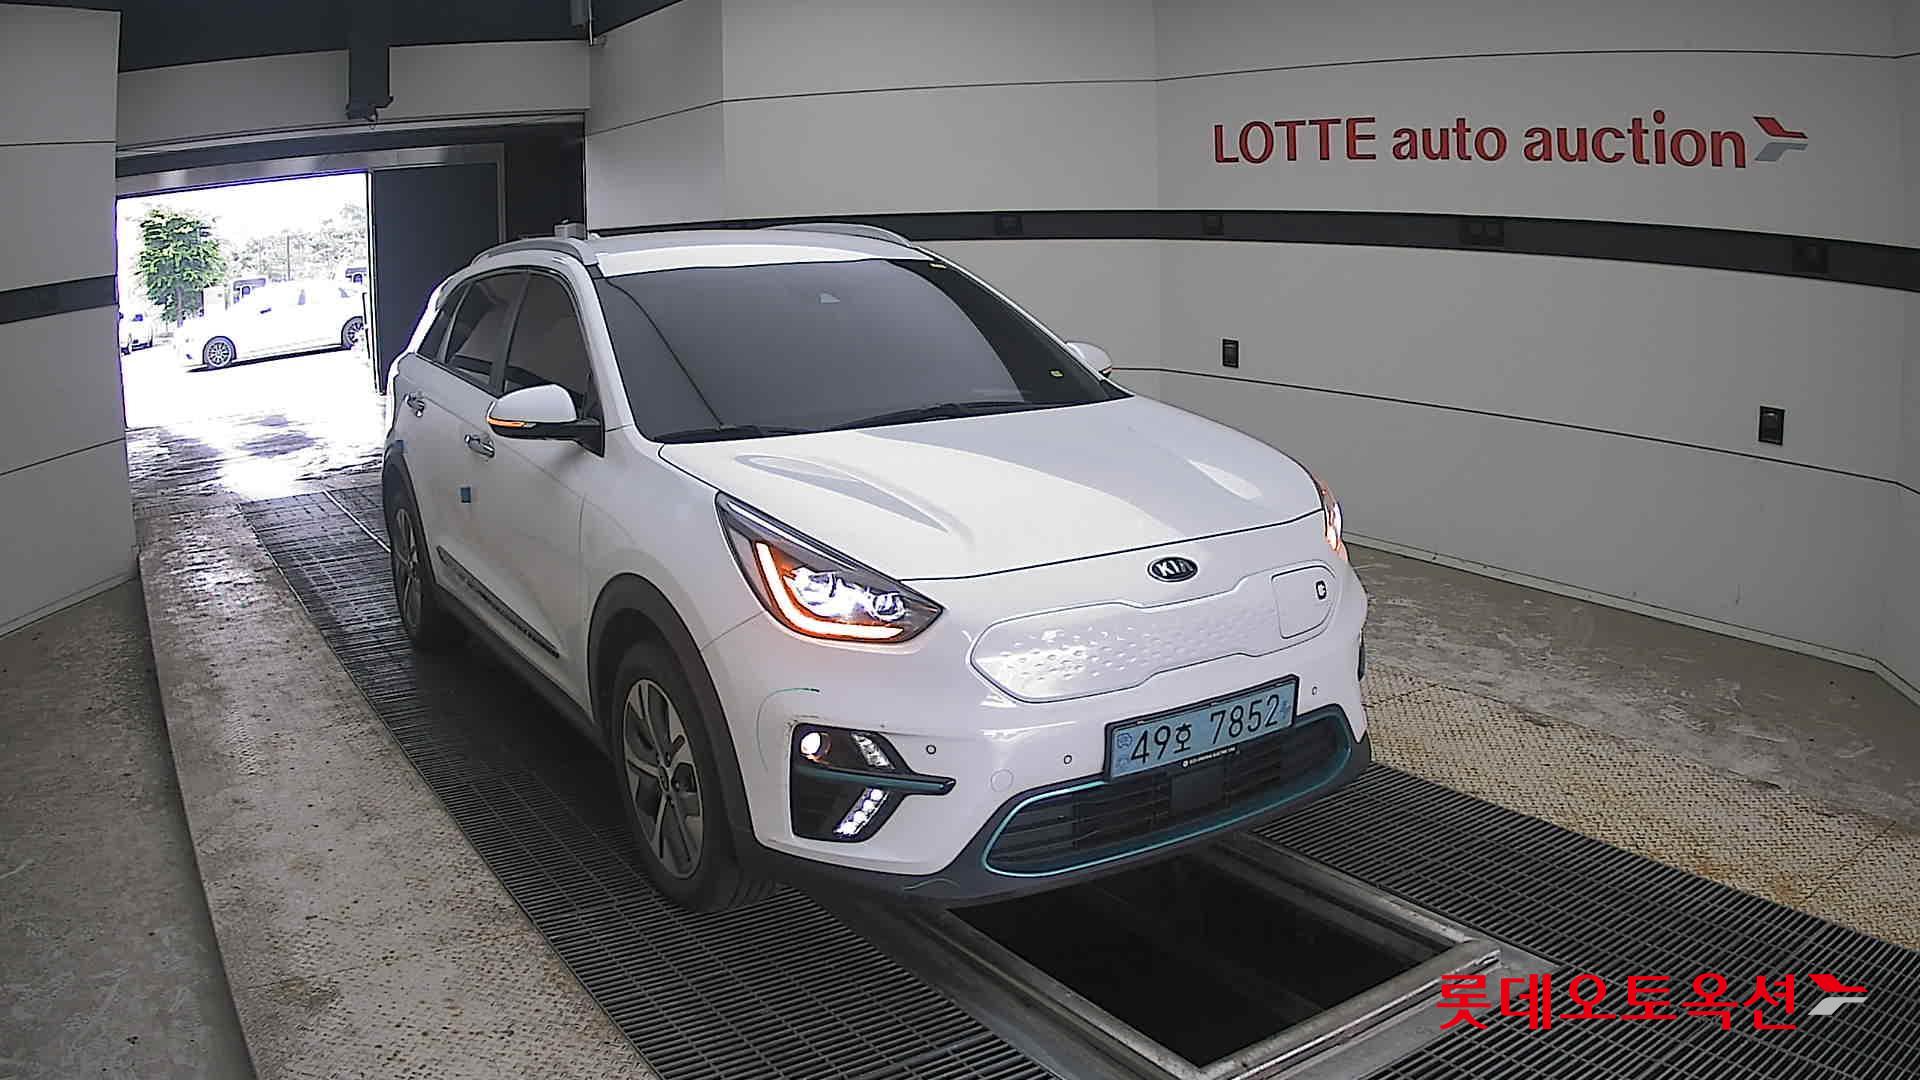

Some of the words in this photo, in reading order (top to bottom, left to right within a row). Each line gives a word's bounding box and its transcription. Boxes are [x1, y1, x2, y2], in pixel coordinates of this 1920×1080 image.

[1213, 117, 1377, 164] LOTTE
[1391, 117, 1508, 162] auto
[1523, 109, 1747, 169] auction
[1154, 560, 1194, 577] KIA
[1130, 721, 1193, 765] 49호
[1209, 694, 1281, 746] 7852
